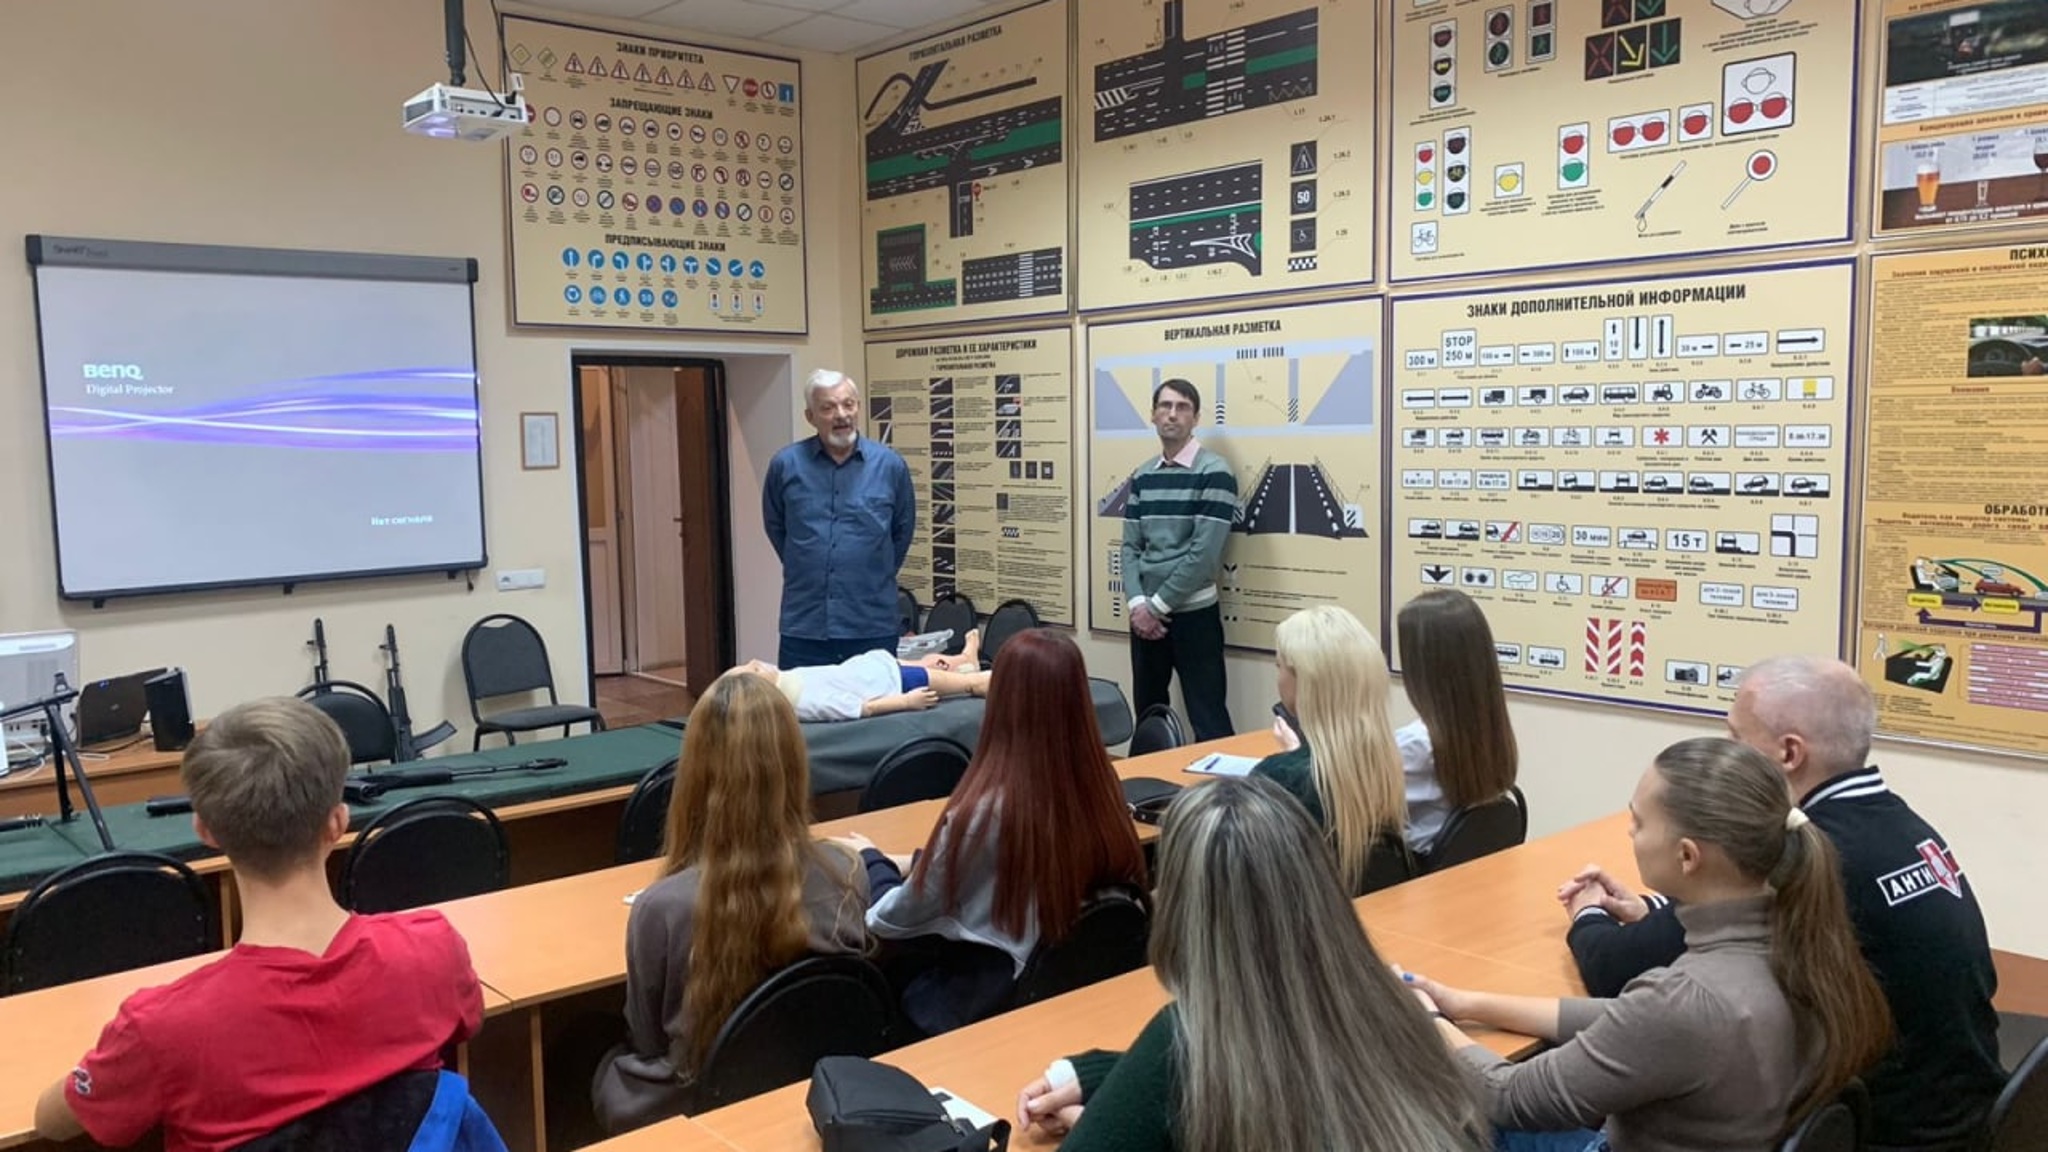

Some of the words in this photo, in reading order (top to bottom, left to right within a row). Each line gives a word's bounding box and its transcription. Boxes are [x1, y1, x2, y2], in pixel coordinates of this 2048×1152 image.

[616, 42, 646, 55] ЗНАКИ
[648, 47, 704, 64] ПРИОРИТЕТА
[610, 97, 682, 116] ЗАПРЕЩАЮЩИЕ
[684, 107, 713, 119] ЗНАКИ
[1297, 190, 1310, 204] 50
[605, 233, 696, 251] ПРЕДПИСЫВАЮЩИЕ
[698, 241, 726, 252] ЗНАКИ
[1467, 302, 1507, 318] ЗНАКИ
[1510, 290, 1635, 317] ДОПОЛНИТЕЛЬНОЙ
[1639, 284, 1746, 306] ИНФОРМАЦИИ
[1164, 323, 1231, 341] ВЕРТИКАЛЬНАЯ
[1232, 319, 1282, 335] РАЗМЕТКА
[1445, 335, 1473, 348] STOP
[1408, 354, 1426, 366] 300
[1445, 350, 1463, 361] 250
[86, 383, 124, 397] Digital
[125, 383, 174, 397] Projector
[371, 516, 390, 526] Нет
[1575, 530, 1588, 542] 30
[1673, 534, 1690, 548] 15
[1693, 537, 1702, 548] т
